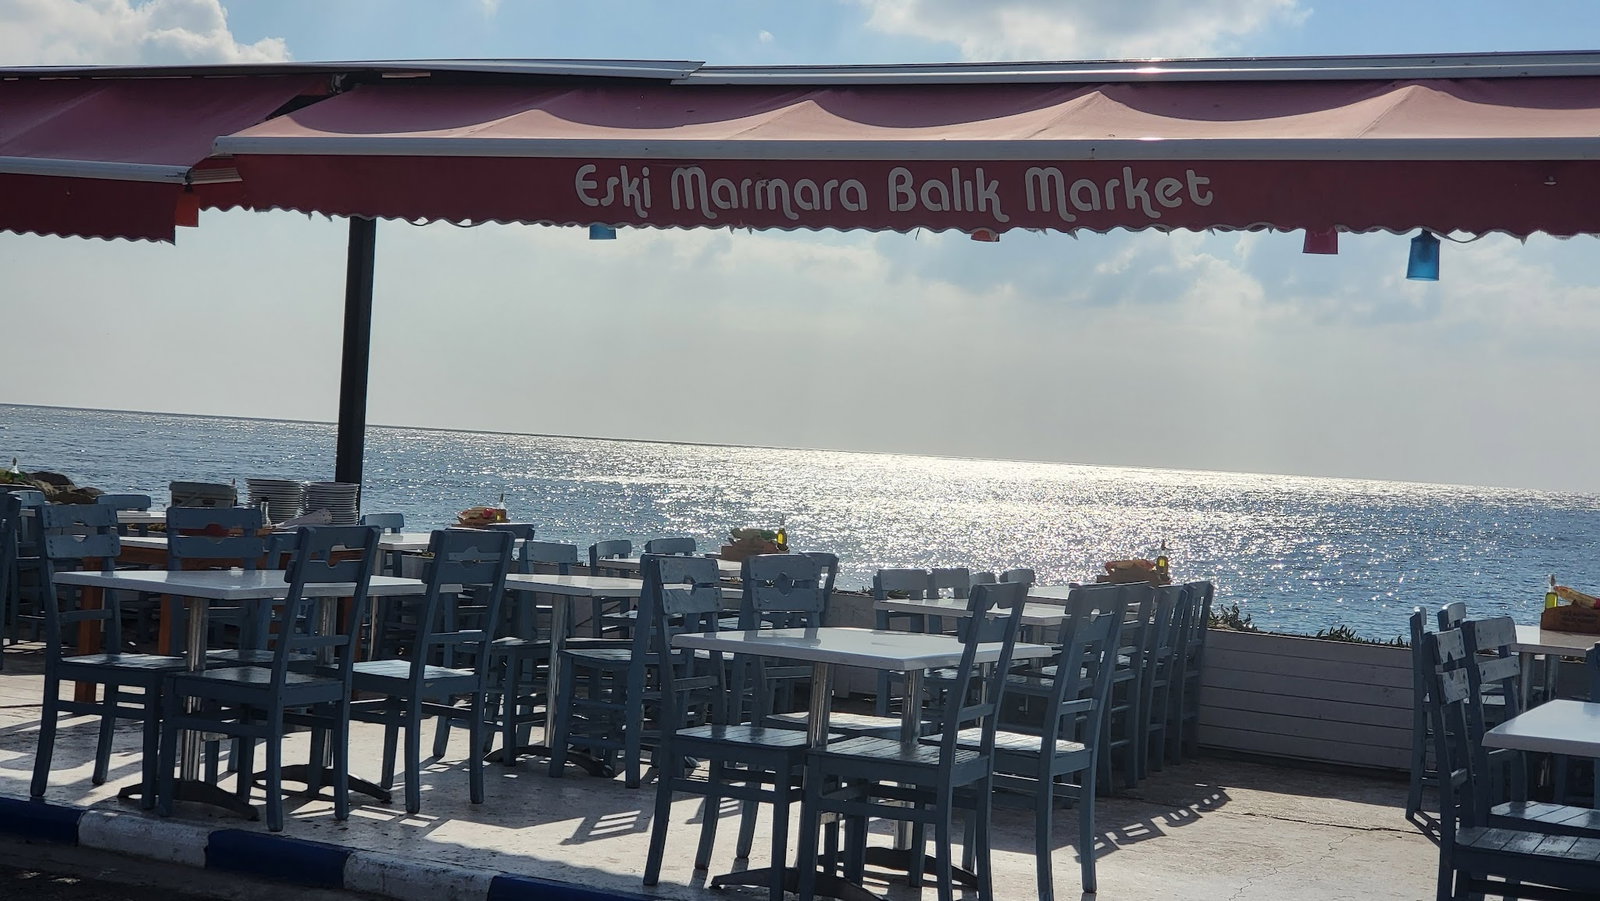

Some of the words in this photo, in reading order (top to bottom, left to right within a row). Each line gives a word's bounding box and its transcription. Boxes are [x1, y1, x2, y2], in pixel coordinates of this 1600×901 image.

[575, 164, 652, 218] Eski
[671, 166, 868, 220] Marmara
[888, 167, 1009, 223] Balık
[1025, 166, 1213, 222] Market
